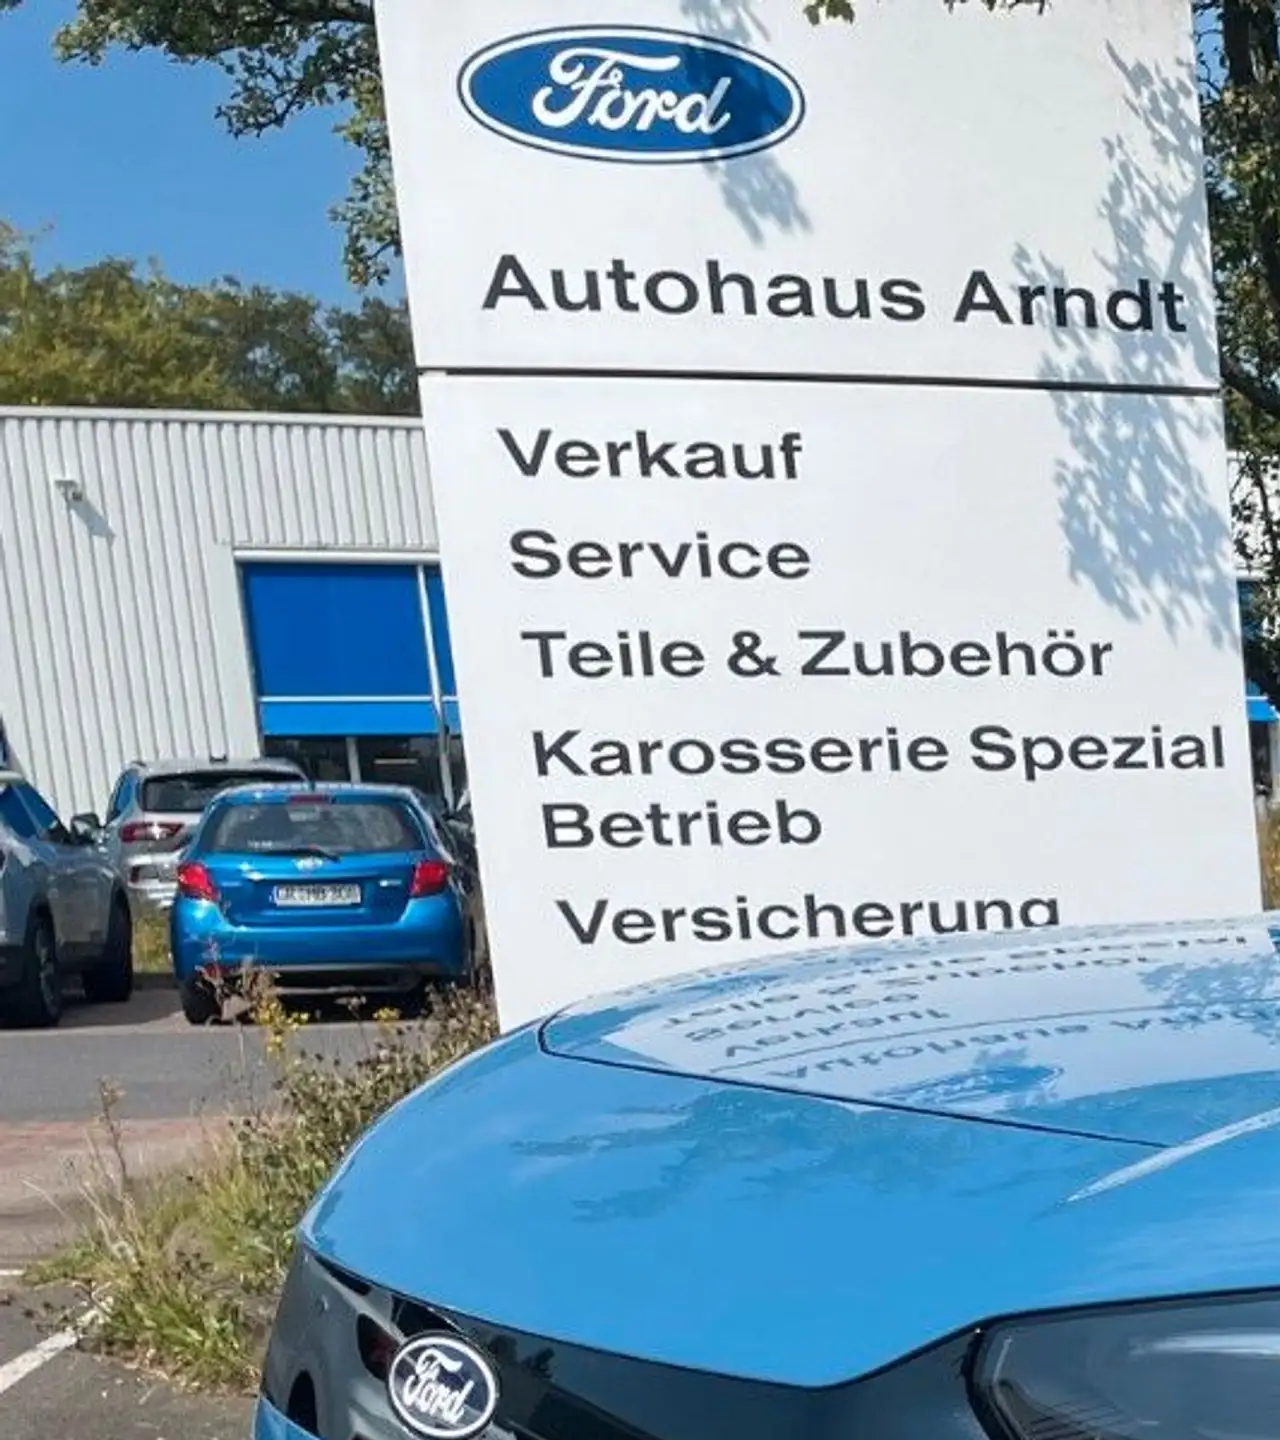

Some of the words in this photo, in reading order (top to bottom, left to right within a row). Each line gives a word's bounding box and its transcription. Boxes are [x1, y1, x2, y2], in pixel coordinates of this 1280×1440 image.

[533, 46, 731, 136] Ford
[483, 254, 926, 321] Autohaus
[953, 270, 1188, 333] Arndt
[497, 428, 803, 480] Verkauf
[510, 529, 811, 580] Service
[520, 630, 705, 679] Teile
[726, 630, 780, 678] &
[798, 629, 1113, 678] Zubehör
[532, 726, 949, 777] Karosserie
[969, 724, 1225, 782] Spezial
[541, 799, 822, 849] Betrieb
[403, 1348, 475, 1424] Ford
